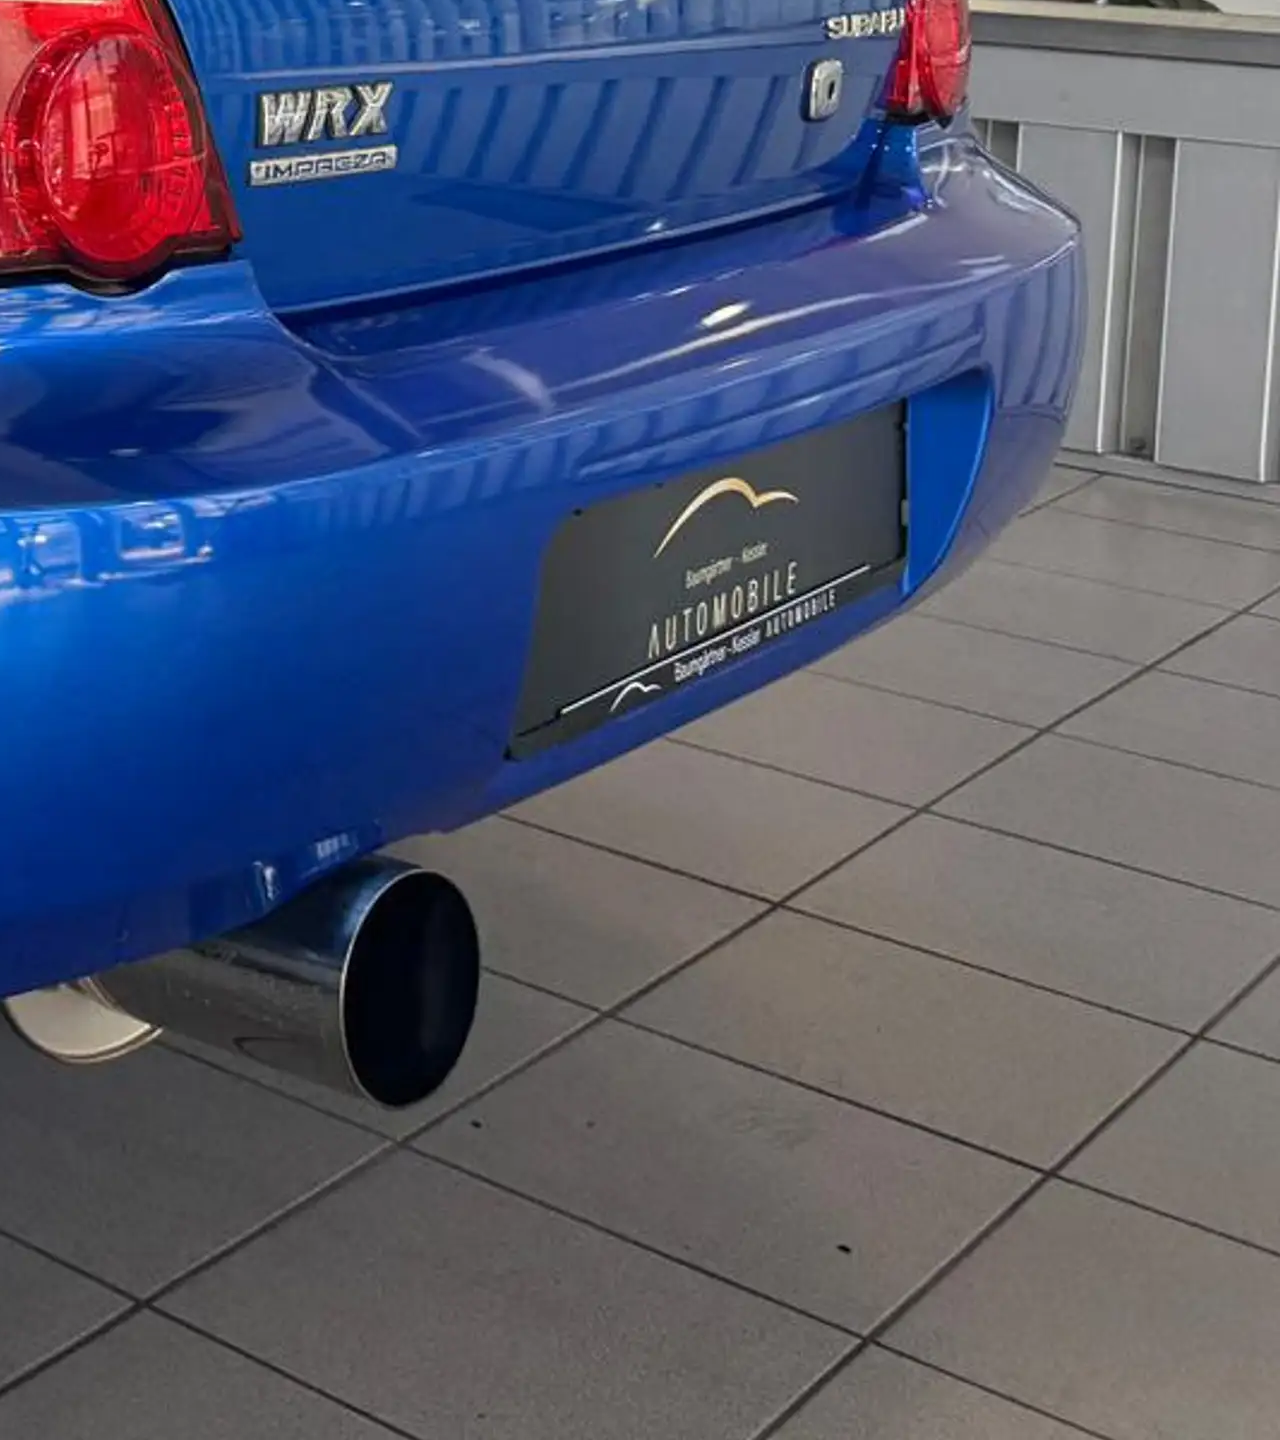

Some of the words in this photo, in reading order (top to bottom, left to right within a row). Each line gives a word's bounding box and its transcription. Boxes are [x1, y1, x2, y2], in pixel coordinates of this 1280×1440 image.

[261, 81, 393, 146] WRX
[263, 151, 387, 181] IMPREZA
[648, 561, 798, 659] AUTOMOBILE
